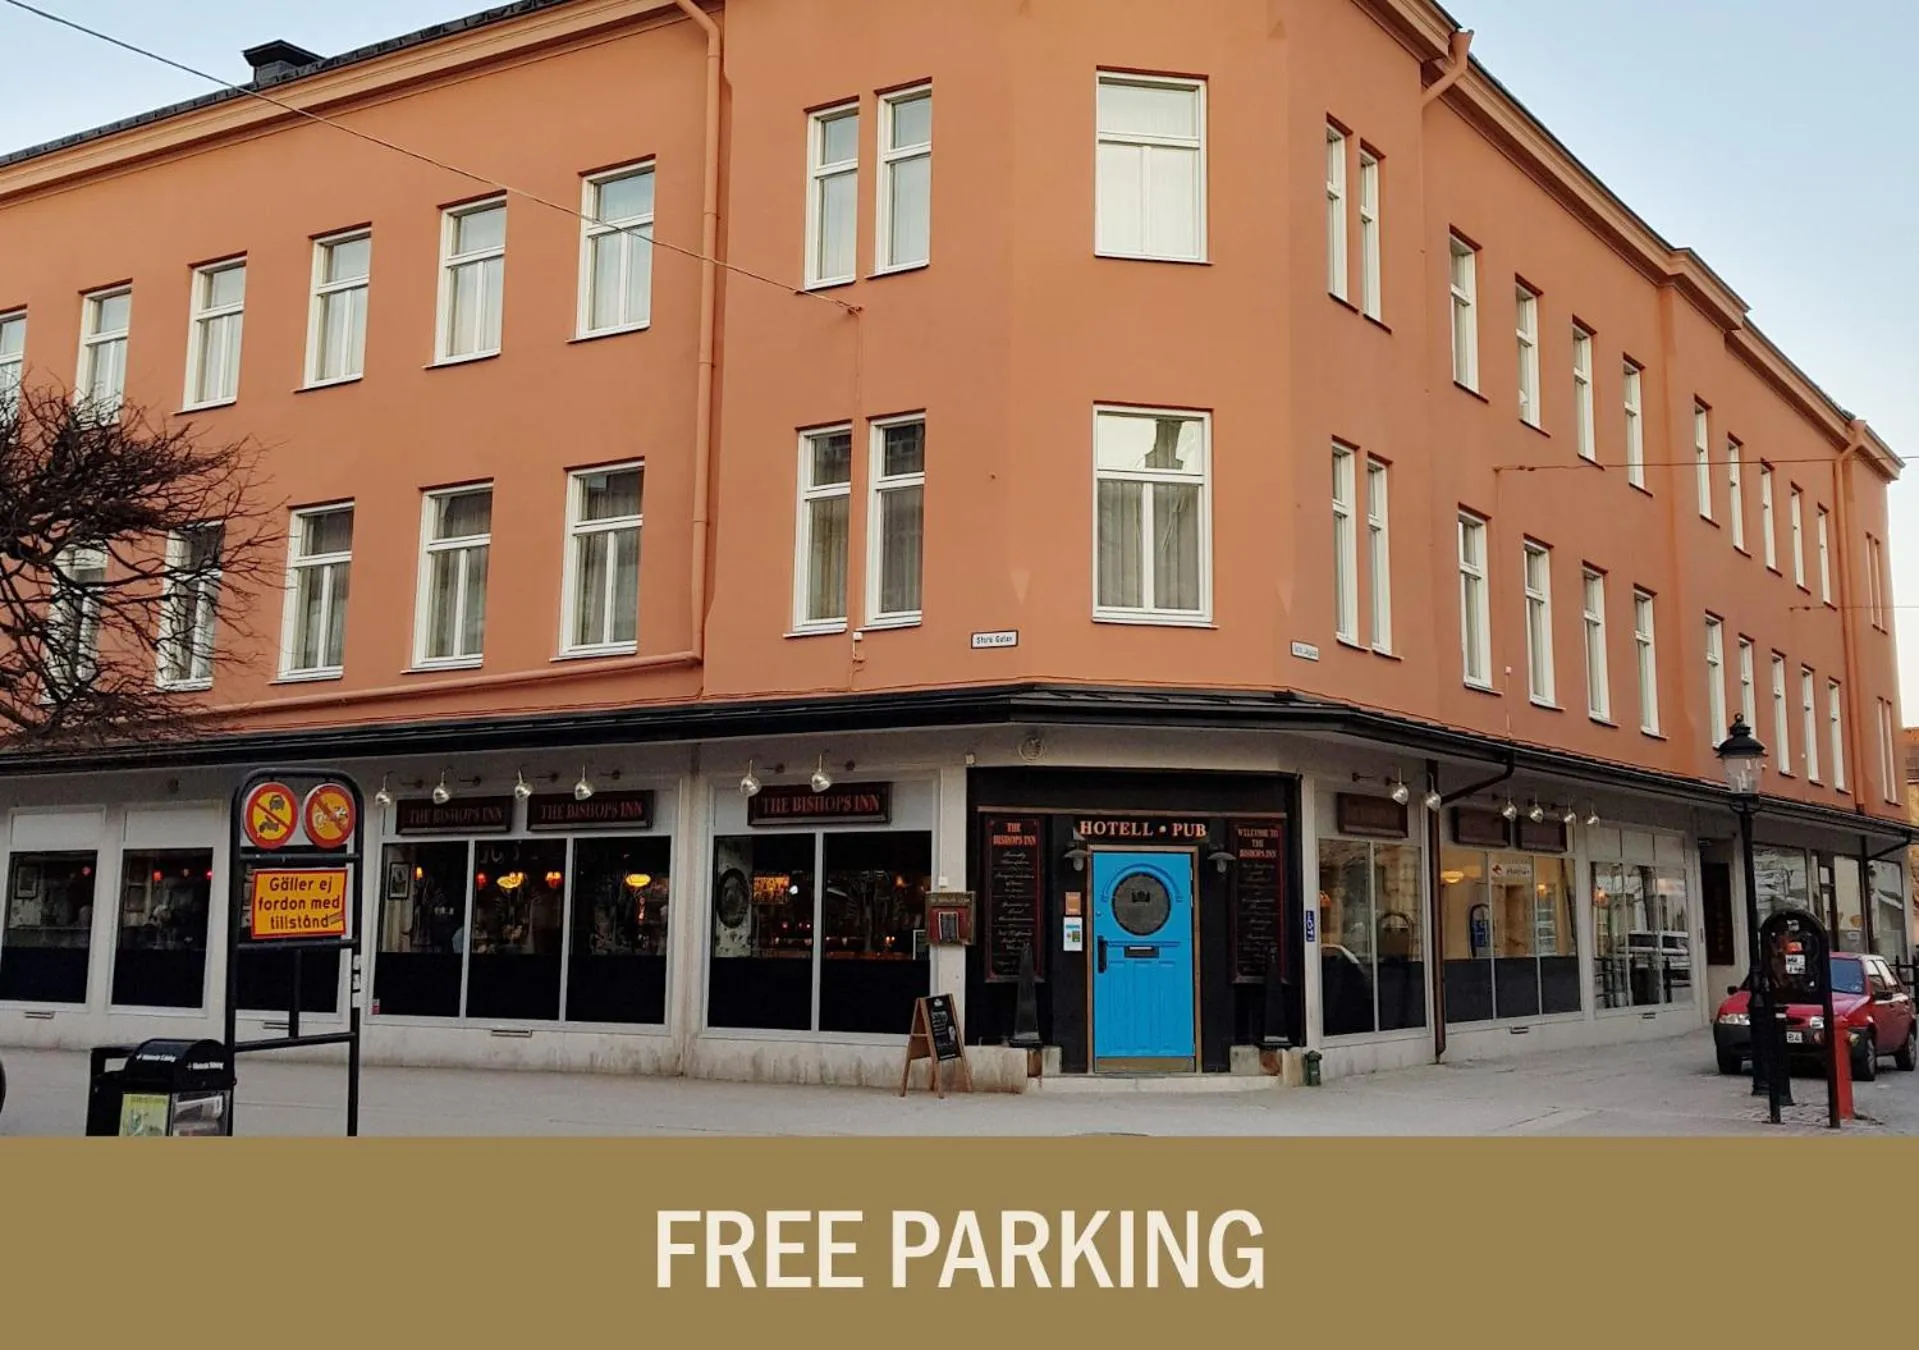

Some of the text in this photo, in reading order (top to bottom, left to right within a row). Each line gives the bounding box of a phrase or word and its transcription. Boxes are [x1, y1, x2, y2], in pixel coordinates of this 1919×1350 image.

[1079, 820, 1207, 837] HOTELL PUB
[269, 876, 333, 893] Gäller ej
[258, 895, 340, 911] fordon med
[270, 914, 329, 930] tillstånd
